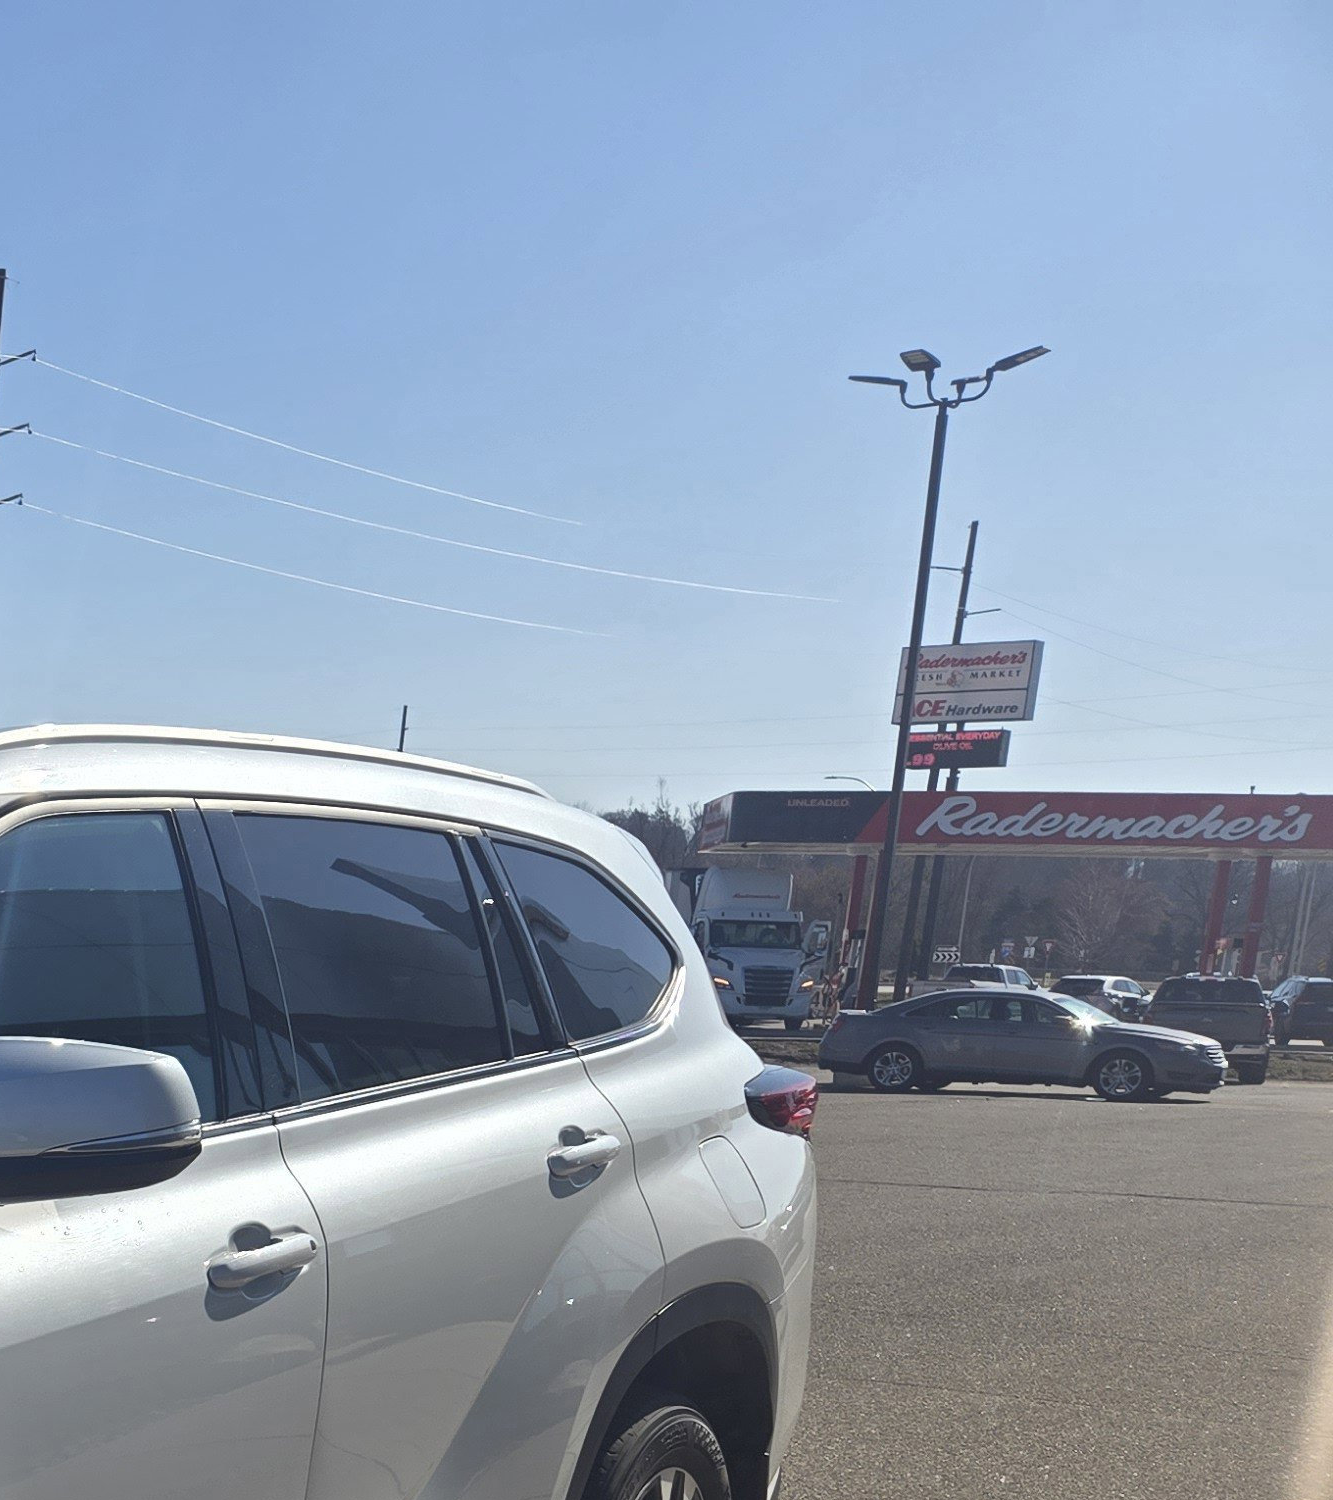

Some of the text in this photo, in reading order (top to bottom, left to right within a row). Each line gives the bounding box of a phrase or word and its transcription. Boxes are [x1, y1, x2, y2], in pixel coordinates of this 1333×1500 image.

[916, 670, 1021, 682] ESH MARKET
[945, 703, 1018, 717] Hardware
[956, 731, 1002, 741] EVERYDAY
[787, 799, 849, 807] UNLEADED
[915, 795, 1314, 842] Radermacher's
